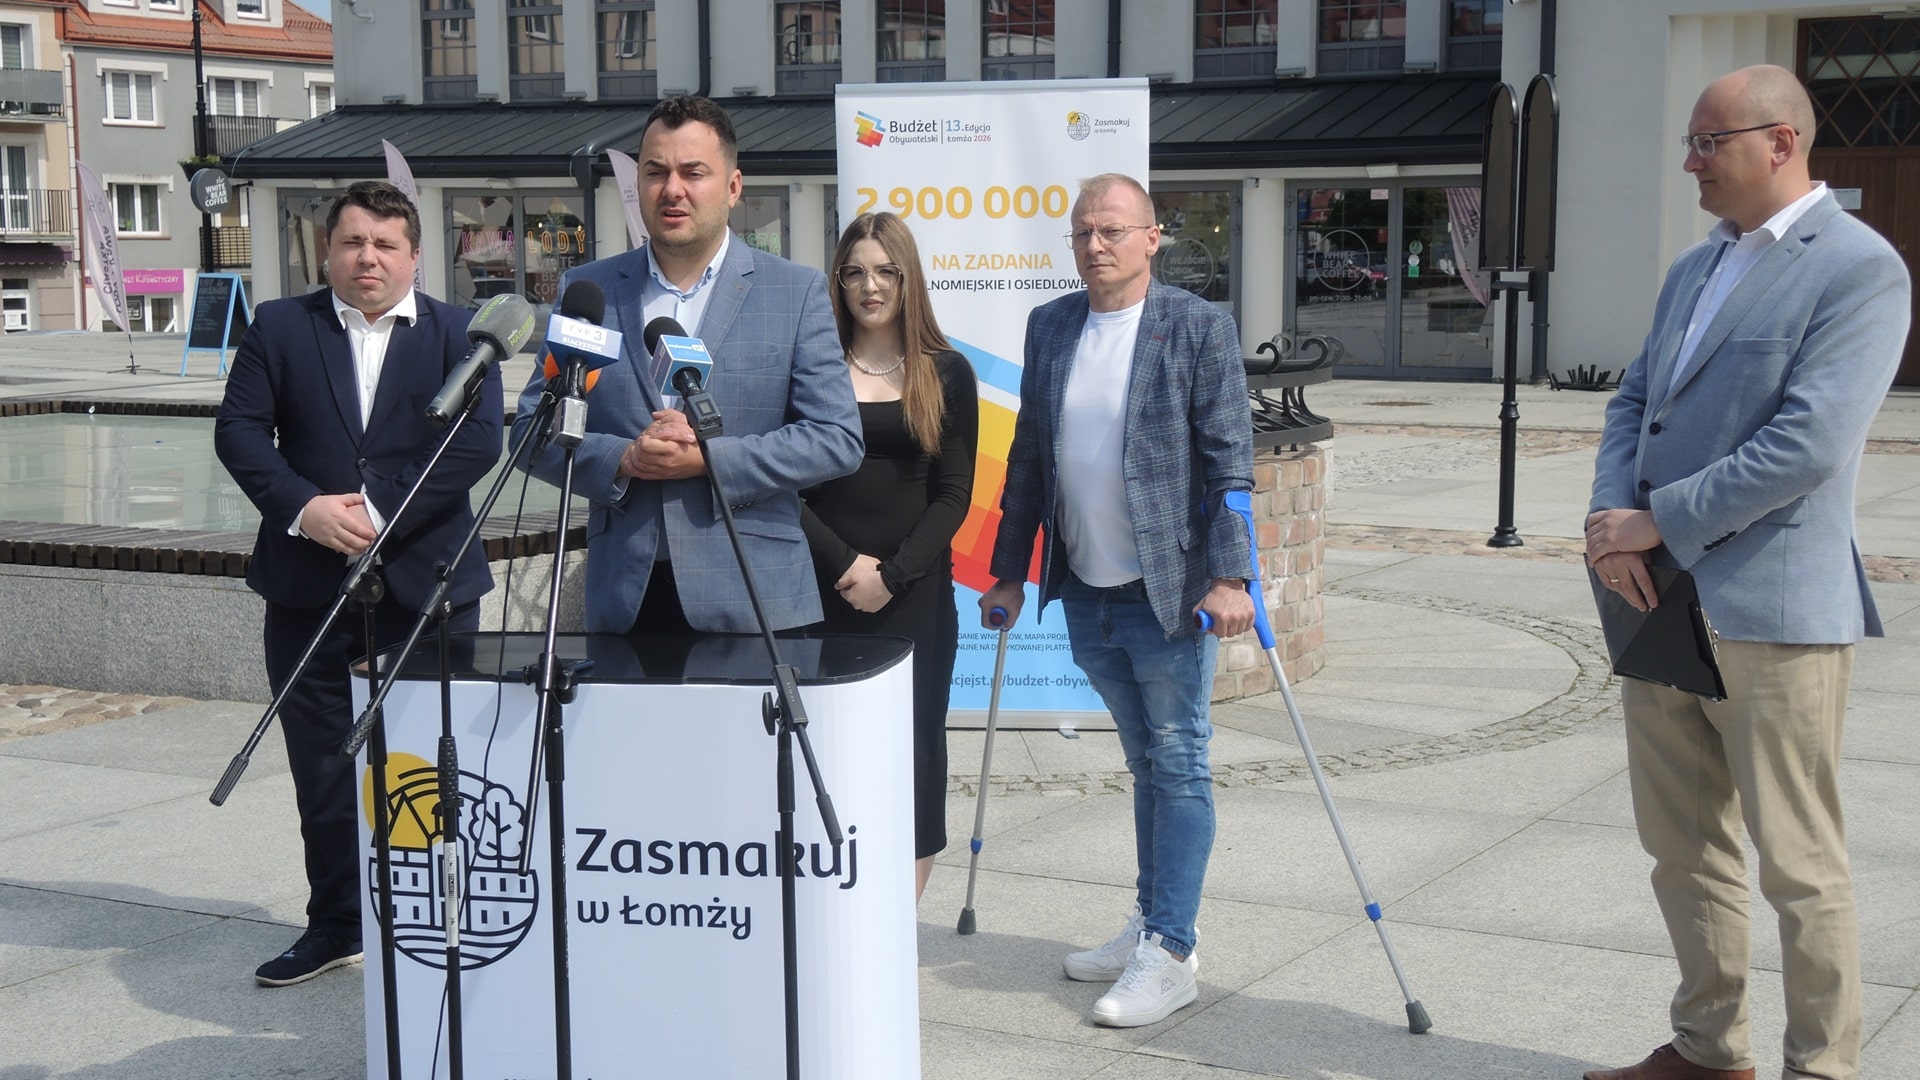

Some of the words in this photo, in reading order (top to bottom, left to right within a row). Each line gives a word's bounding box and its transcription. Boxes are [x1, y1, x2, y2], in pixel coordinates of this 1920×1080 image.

[889, 119, 938, 133] Budżet
[1094, 118, 1130, 128] Zasmakuj
[889, 135, 938, 145] Obywatelski
[947, 135, 972, 143] Łomża
[205, 183, 226, 194] WHITE
[210, 189, 228, 200] BEAR
[205, 196, 229, 207] COFFEE
[856, 187, 879, 216] 2
[888, 186, 973, 220] 900
[983, 185, 1069, 219] 000
[461, 230, 516, 255] KAWA
[527, 230, 586, 254] LODY
[932, 254, 961, 270] NA
[964, 253, 1053, 270] ZADANIA
[1322, 260, 1349, 268] BEAR
[1322, 269, 1360, 278] COFFEE
[1014, 278, 1088, 290] OSIEDLOWE
[574, 825, 858, 890] Zasmakuj
[577, 899, 609, 924] w
[619, 895, 752, 940] Łomży
